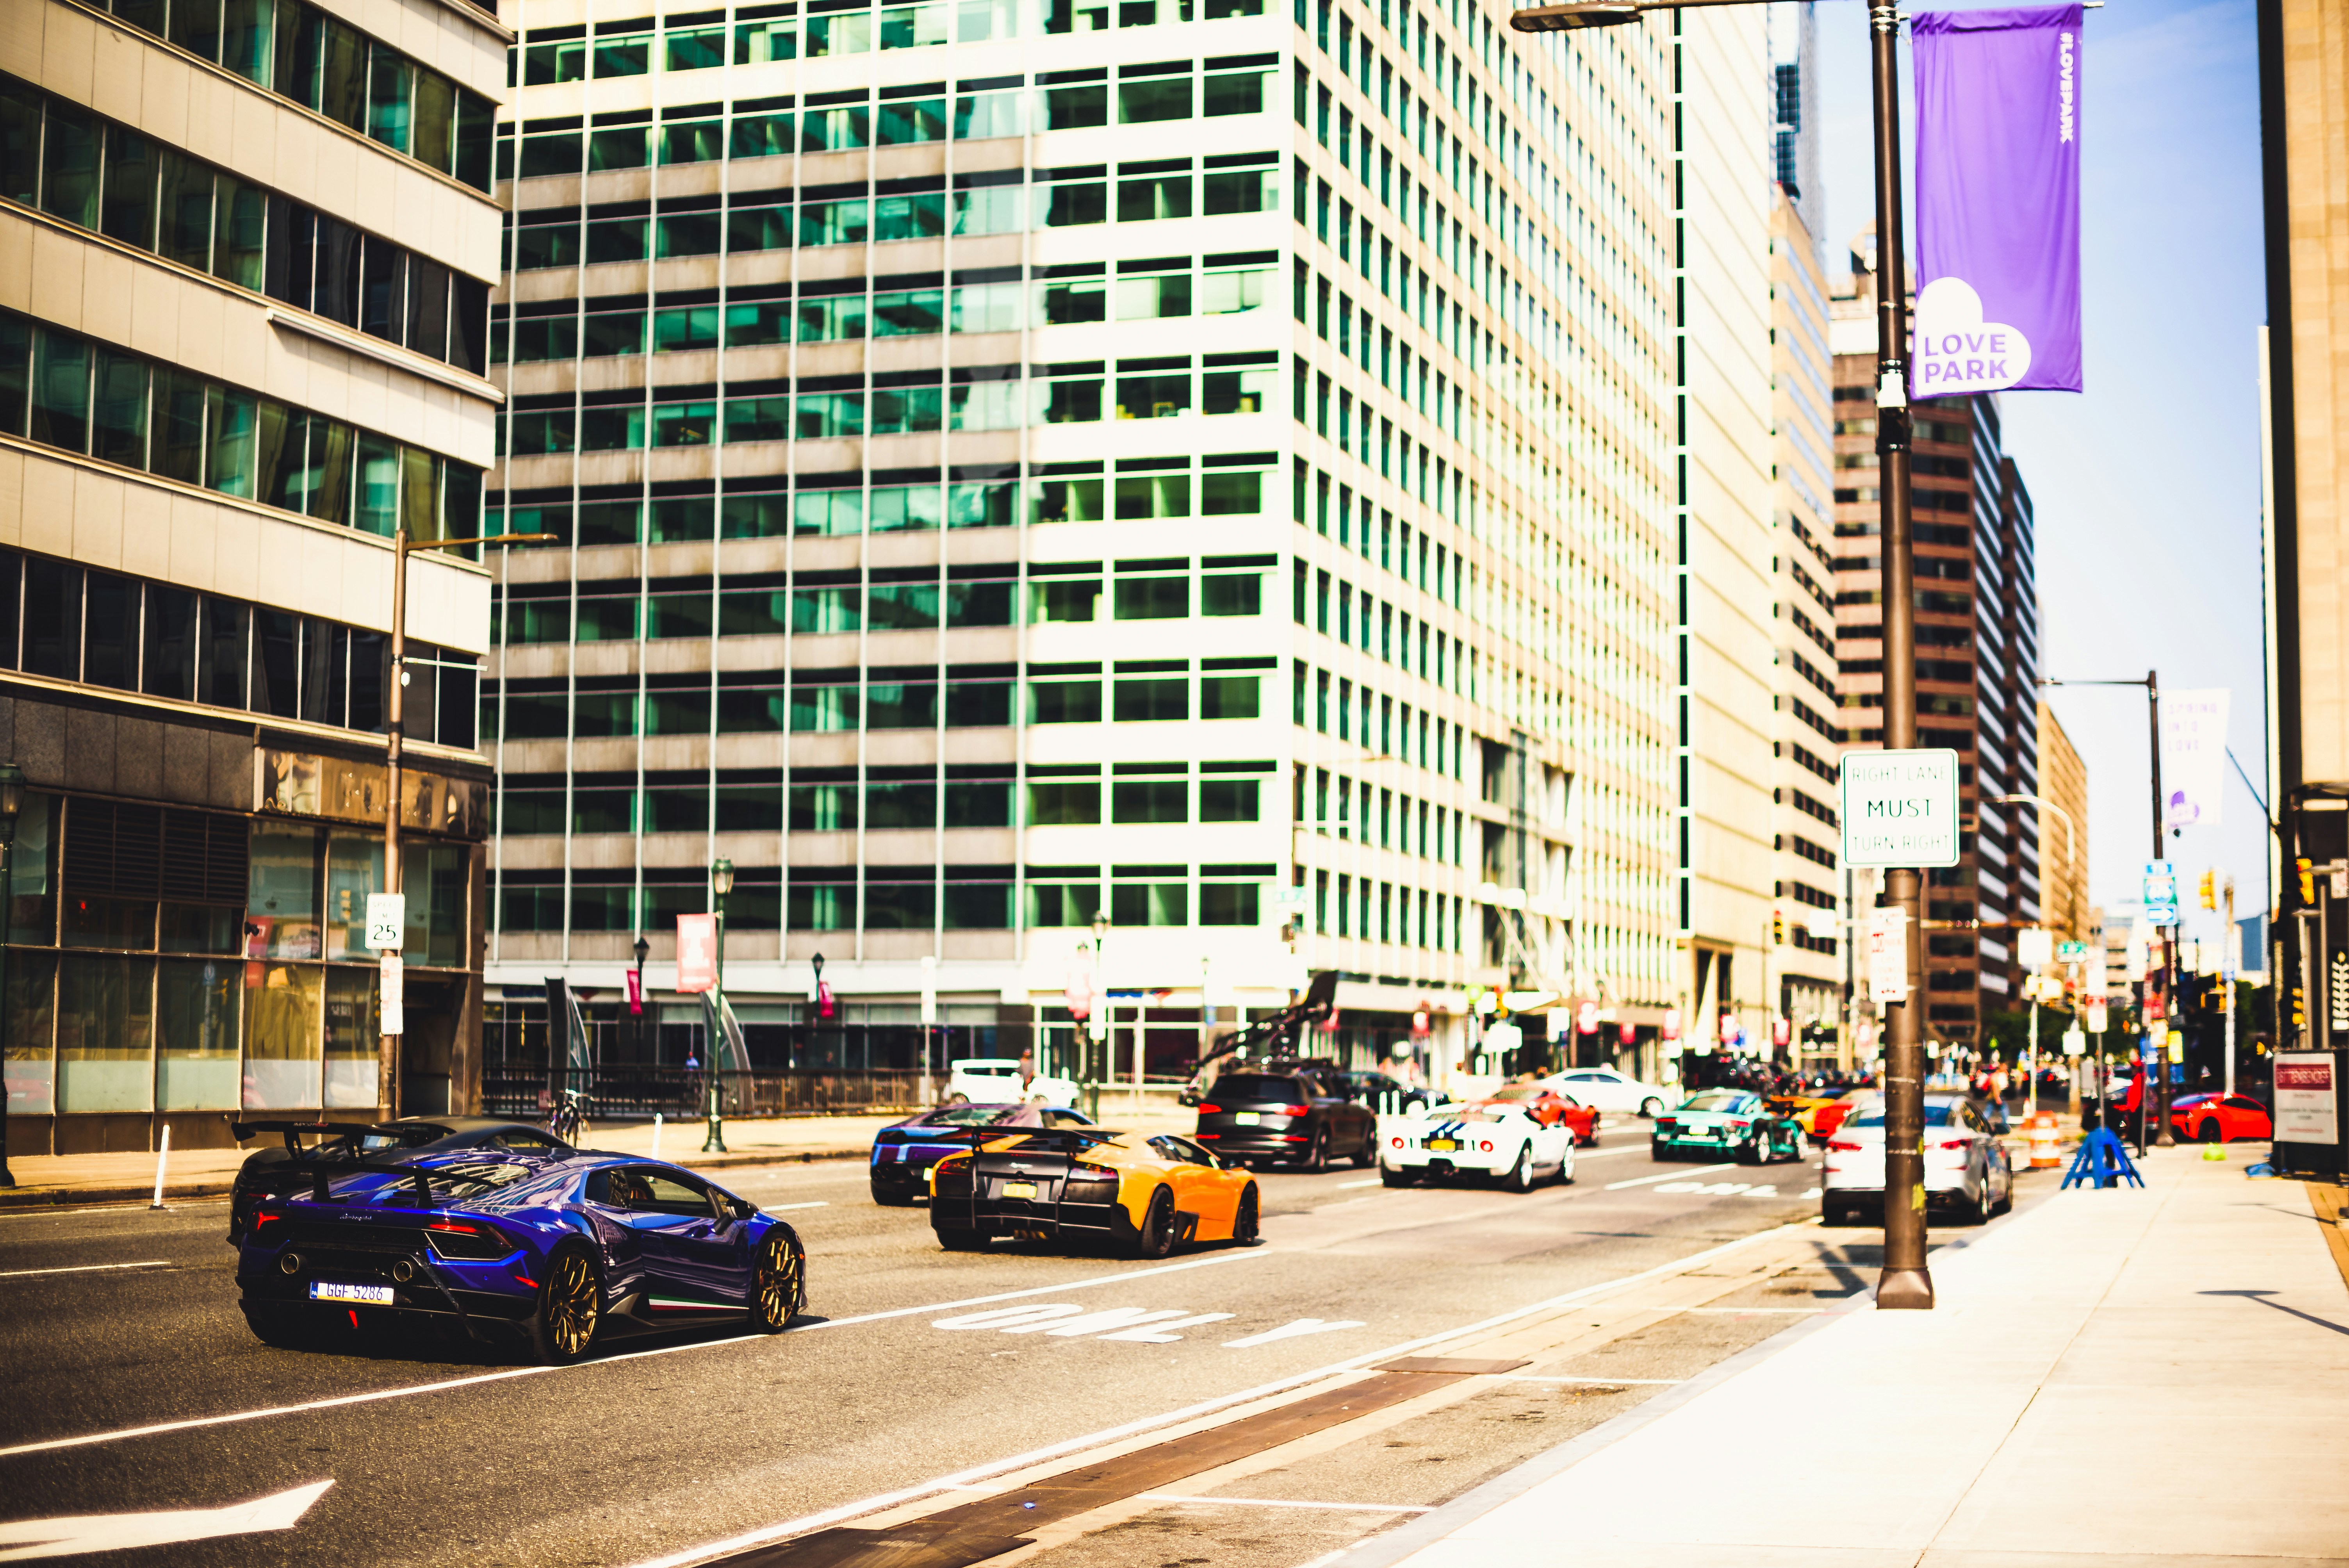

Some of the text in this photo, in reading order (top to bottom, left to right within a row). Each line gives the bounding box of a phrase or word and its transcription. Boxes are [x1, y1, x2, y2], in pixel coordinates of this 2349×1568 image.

[2060, 32, 2074, 144] #LOVEPARK
[1925, 334, 2006, 356] LOVE
[1925, 360, 2009, 383] PARK
[1853, 766, 1946, 781] RIGHT LANE
[1868, 798, 1934, 817] MUST
[1854, 835, 1948, 851] TURN RIGHT
[374, 924, 396, 941] 25
[354, 1285, 383, 1301] 5286
